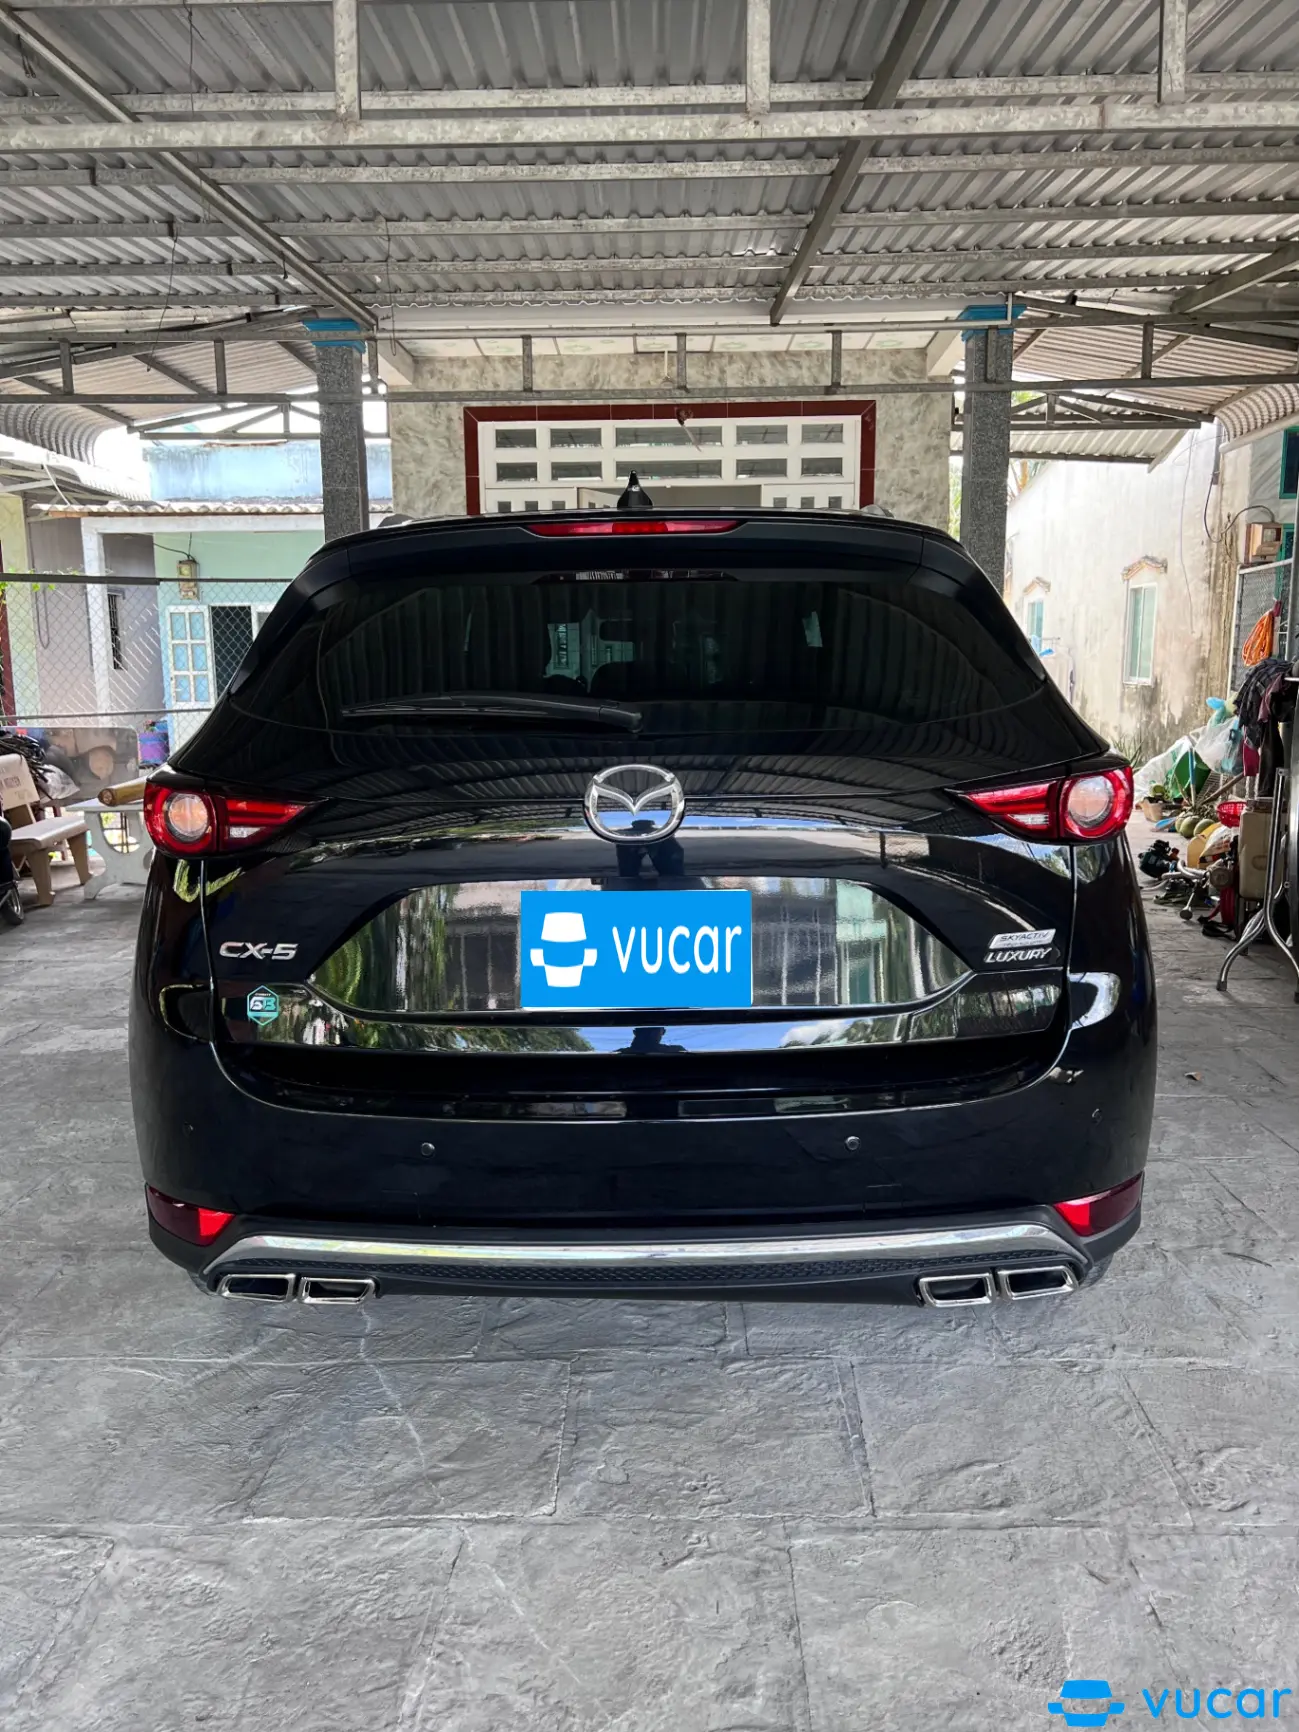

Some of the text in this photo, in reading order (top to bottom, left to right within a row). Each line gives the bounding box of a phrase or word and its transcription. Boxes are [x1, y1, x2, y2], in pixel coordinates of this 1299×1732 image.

[1000, 932, 1050, 942] SKYACTIV
[219, 941, 299, 960] CX-5
[984, 947, 1053, 963] LUXURY
